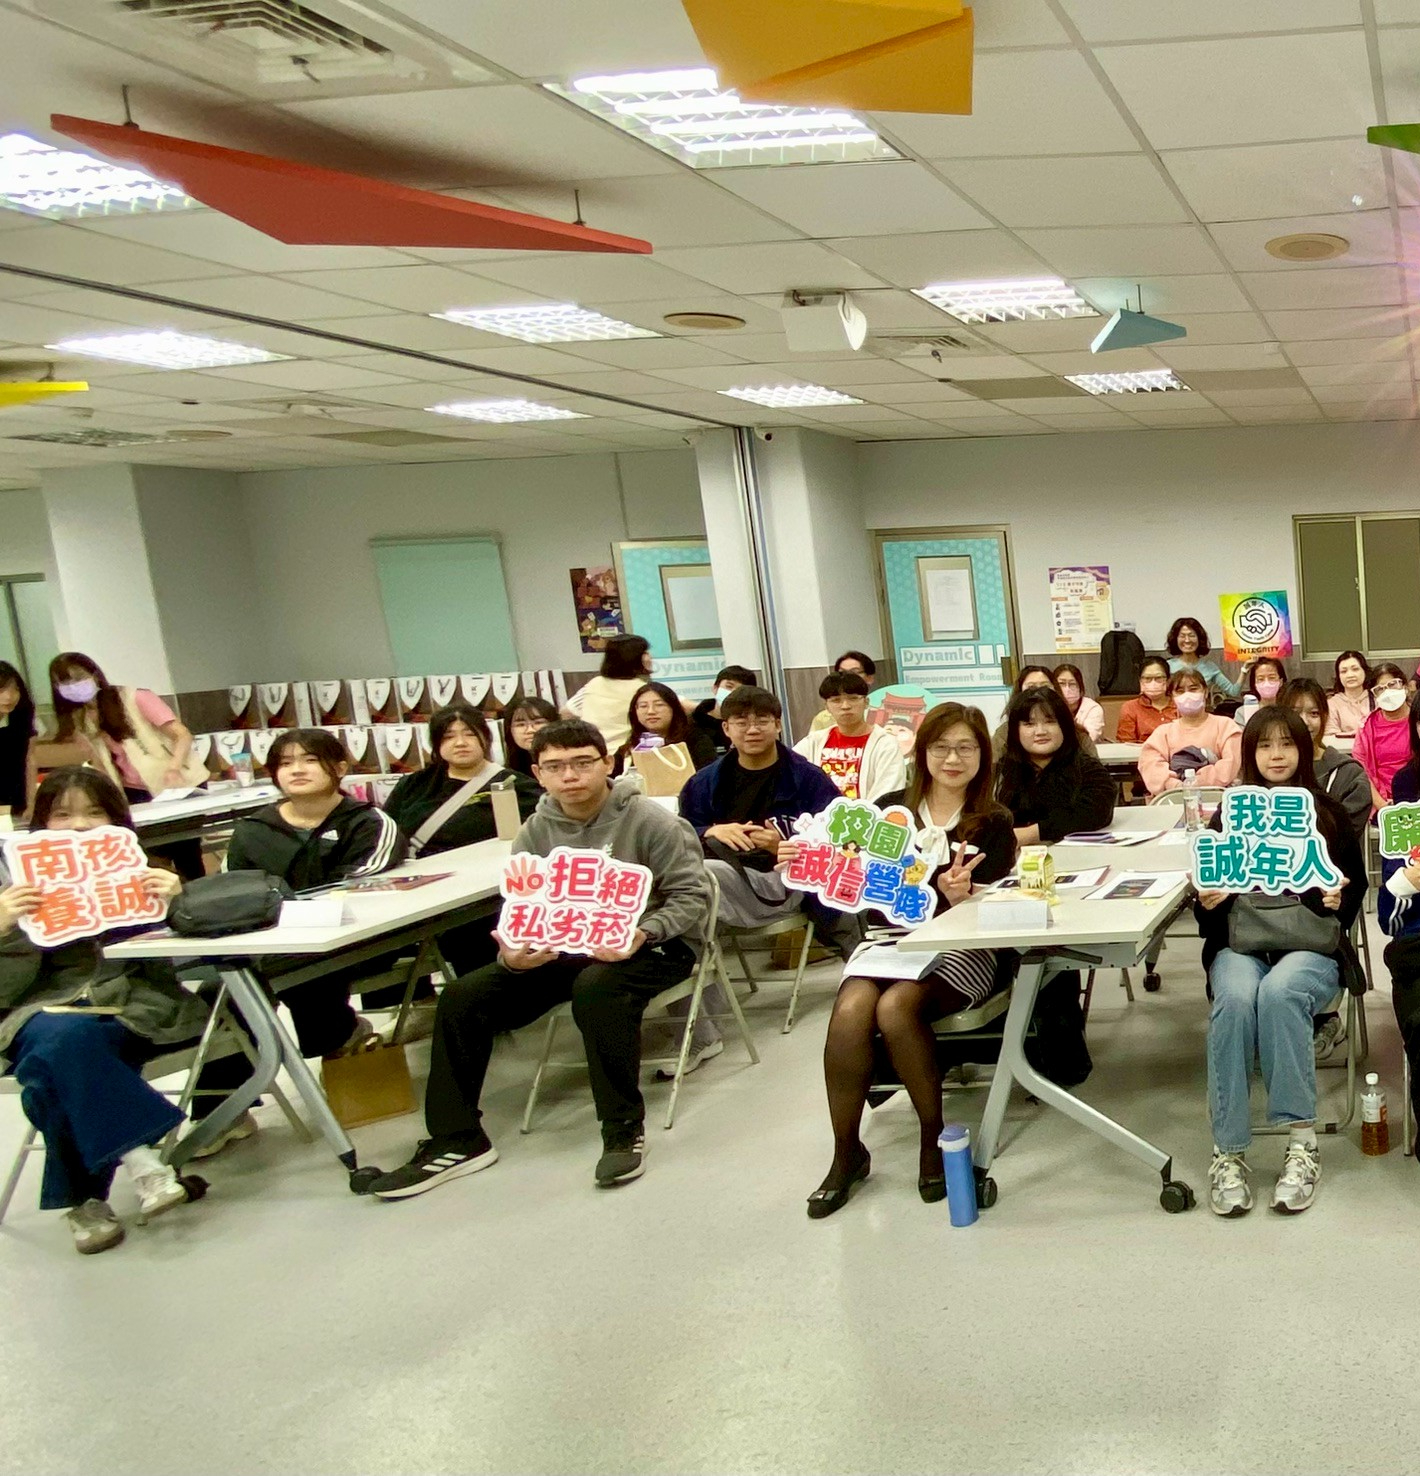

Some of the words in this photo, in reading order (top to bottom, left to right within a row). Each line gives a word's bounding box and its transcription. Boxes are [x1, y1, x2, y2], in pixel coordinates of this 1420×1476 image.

[903, 648, 973, 665] Dynamic
[1237, 645, 1279, 655] INTEGRITY
[905, 674, 974, 685] Empowerment
[828, 804, 909, 860] 校園
[1230, 794, 1306, 833] 我是
[17, 833, 133, 885] 南孩
[550, 854, 642, 908] 拒絕
[788, 842, 929, 920] 誠信營隊
[1197, 835, 1334, 885] 誠年人
[32, 875, 156, 936] 養誠
[506, 873, 544, 893] NO
[508, 905, 627, 945] 私劣菸
